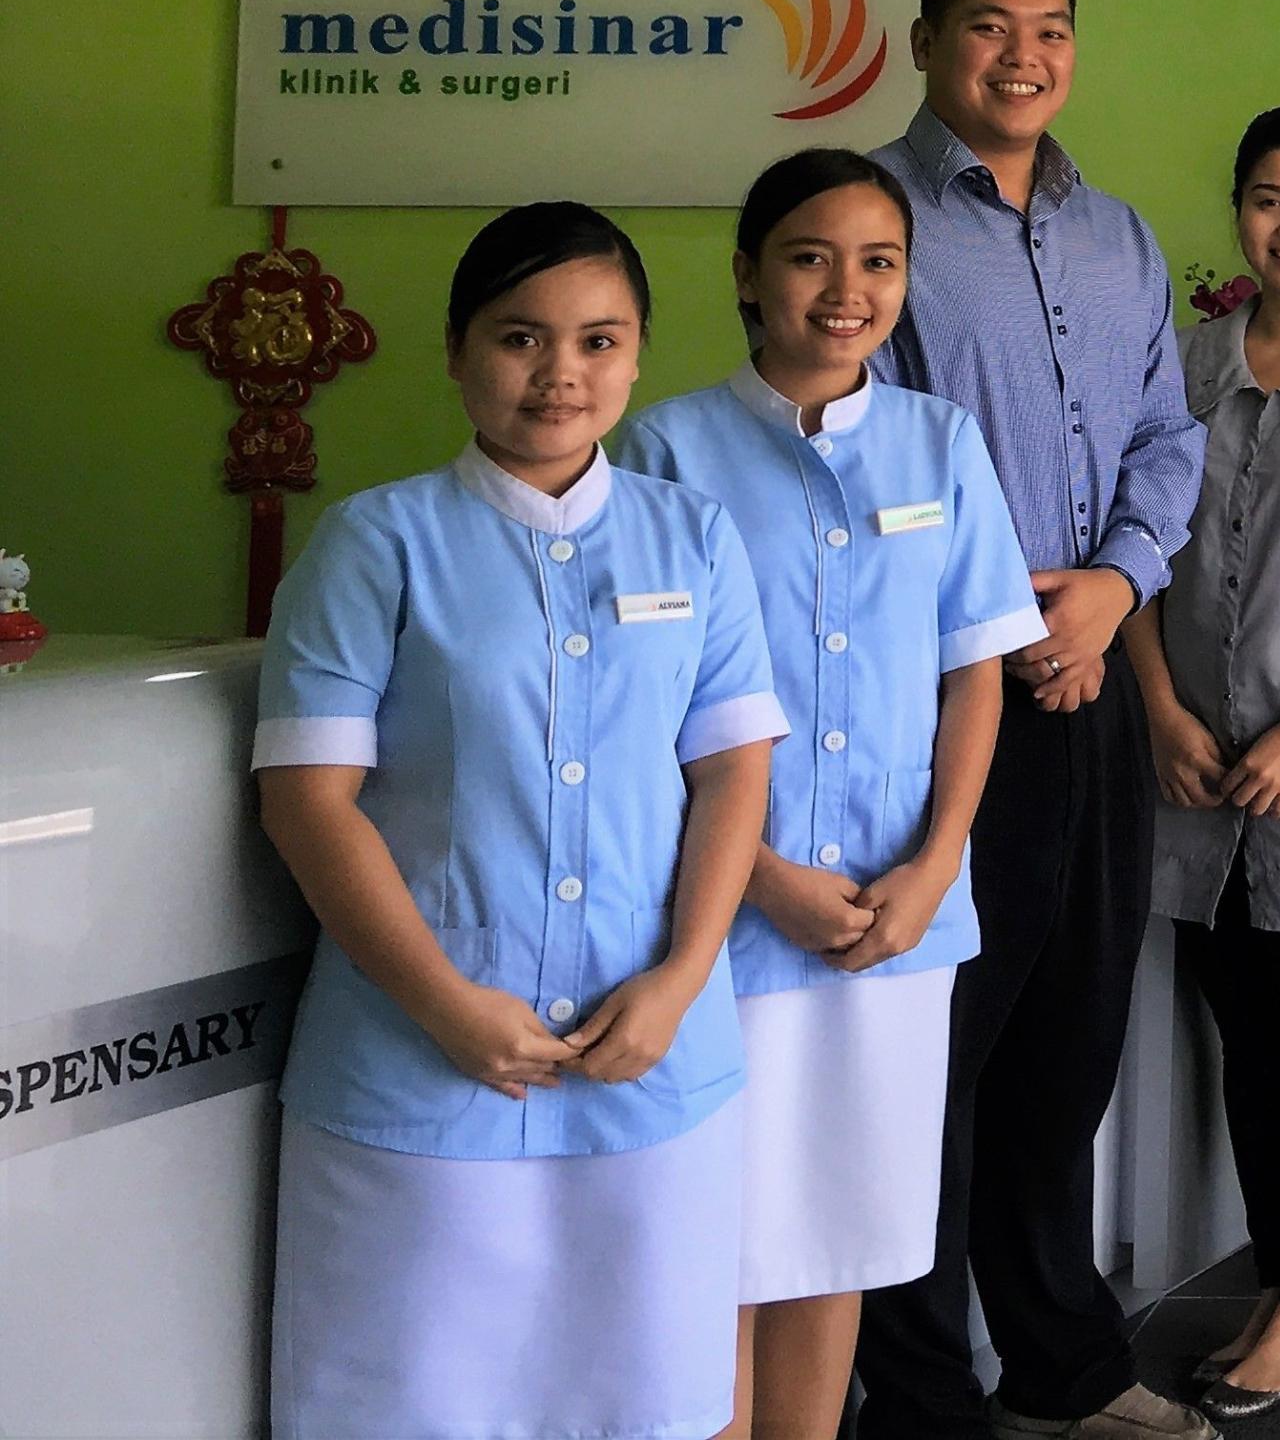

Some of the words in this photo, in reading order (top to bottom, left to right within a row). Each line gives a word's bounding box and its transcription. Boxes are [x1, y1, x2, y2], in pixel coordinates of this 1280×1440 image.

[280, 70, 379, 95] klinik
[399, 71, 421, 96] &
[441, 70, 570, 101] surgeri
